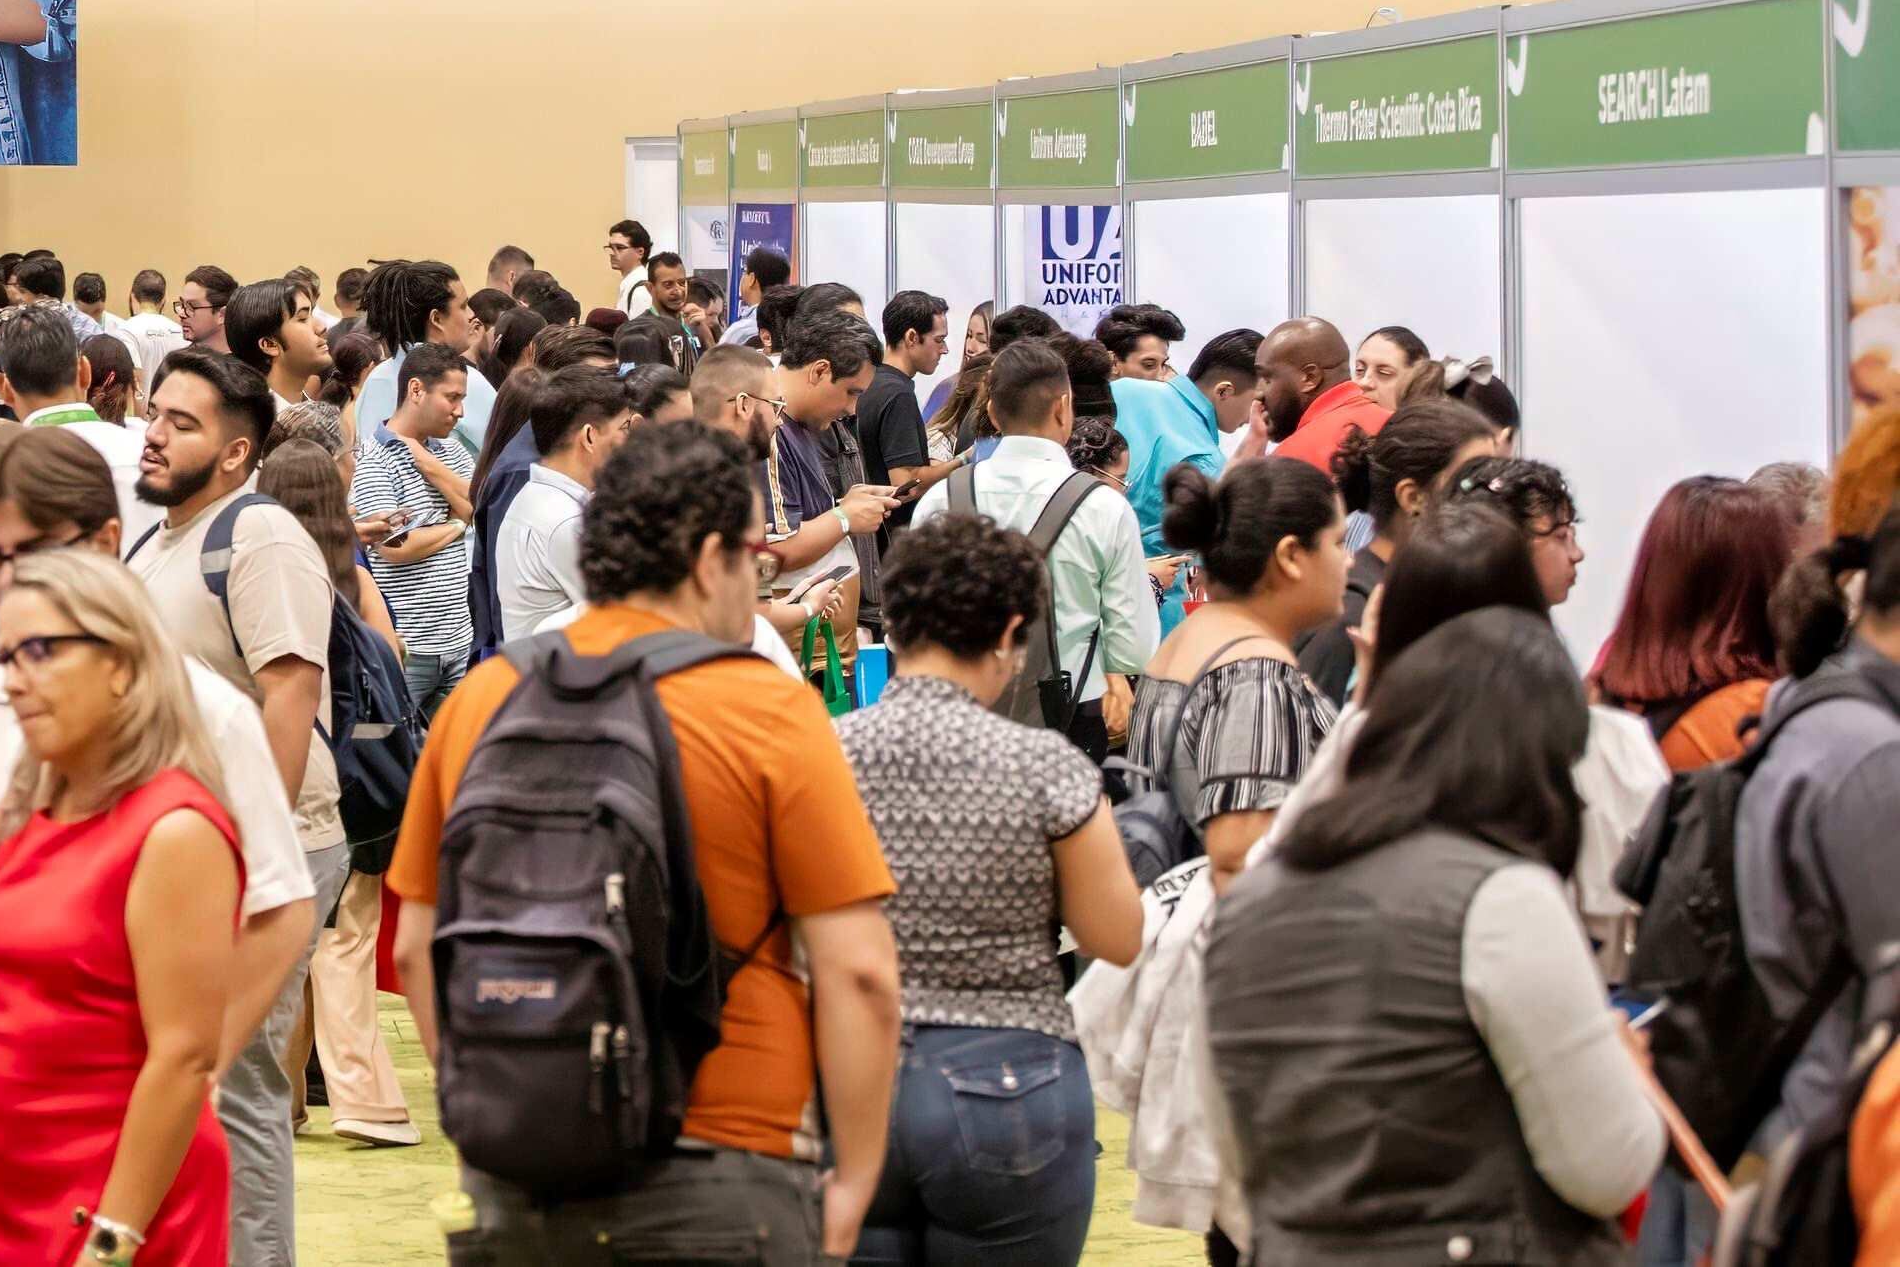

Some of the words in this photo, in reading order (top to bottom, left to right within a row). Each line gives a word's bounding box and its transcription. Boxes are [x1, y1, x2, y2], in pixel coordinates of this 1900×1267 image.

[1314, 103, 1348, 144] Thermo
[1380, 91, 1425, 139] Scientific
[1426, 91, 1456, 135] Costa
[1457, 85, 1482, 132] Rica
[1598, 70, 1659, 125] SEARCH
[1661, 67, 1710, 118] Latam
